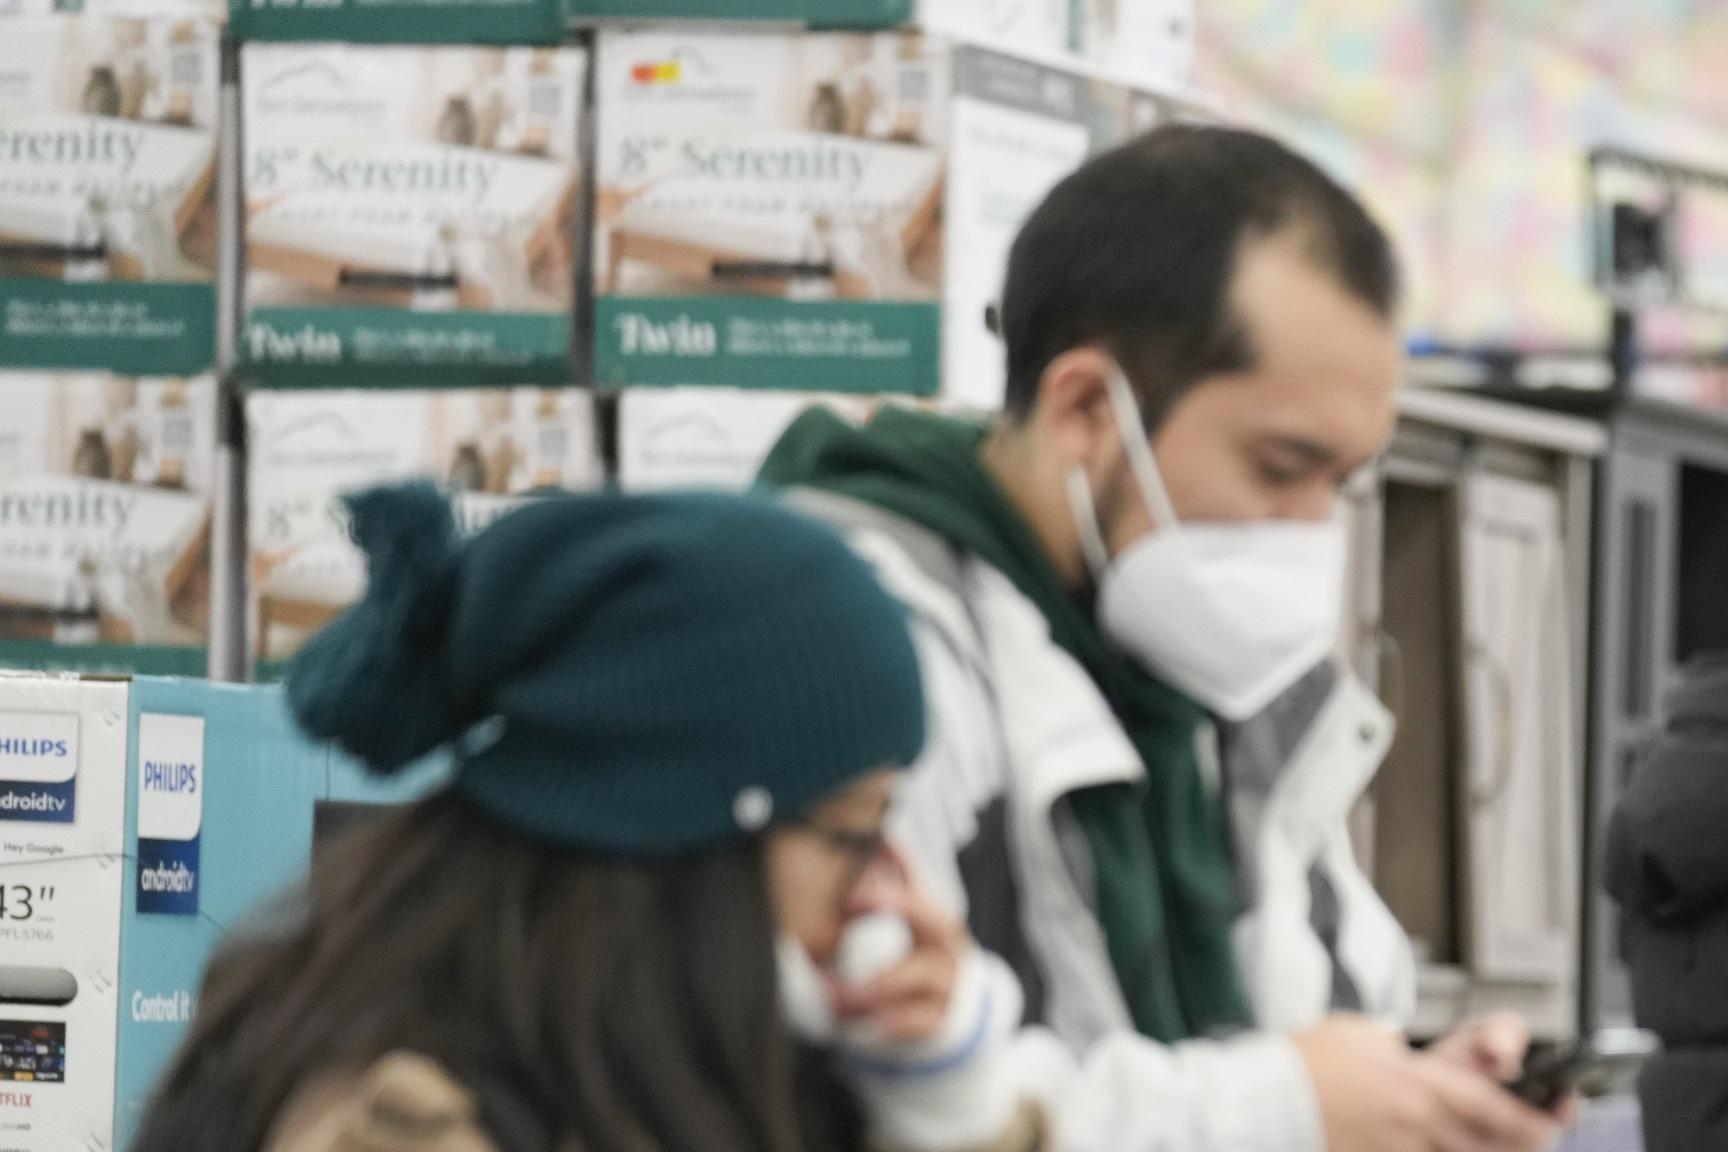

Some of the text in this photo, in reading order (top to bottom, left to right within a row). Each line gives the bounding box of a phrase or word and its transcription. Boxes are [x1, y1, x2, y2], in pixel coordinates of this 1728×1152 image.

[311, 146, 499, 205] Serenity
[680, 135, 871, 193] Serenity
[248, 322, 341, 363] Twin
[615, 312, 717, 356] Twin
[144, 761, 196, 794] PHILIPS
[4, 843, 65, 855] Hey Google
[141, 860, 195, 893] androidtv
[132, 989, 179, 1023] Control
